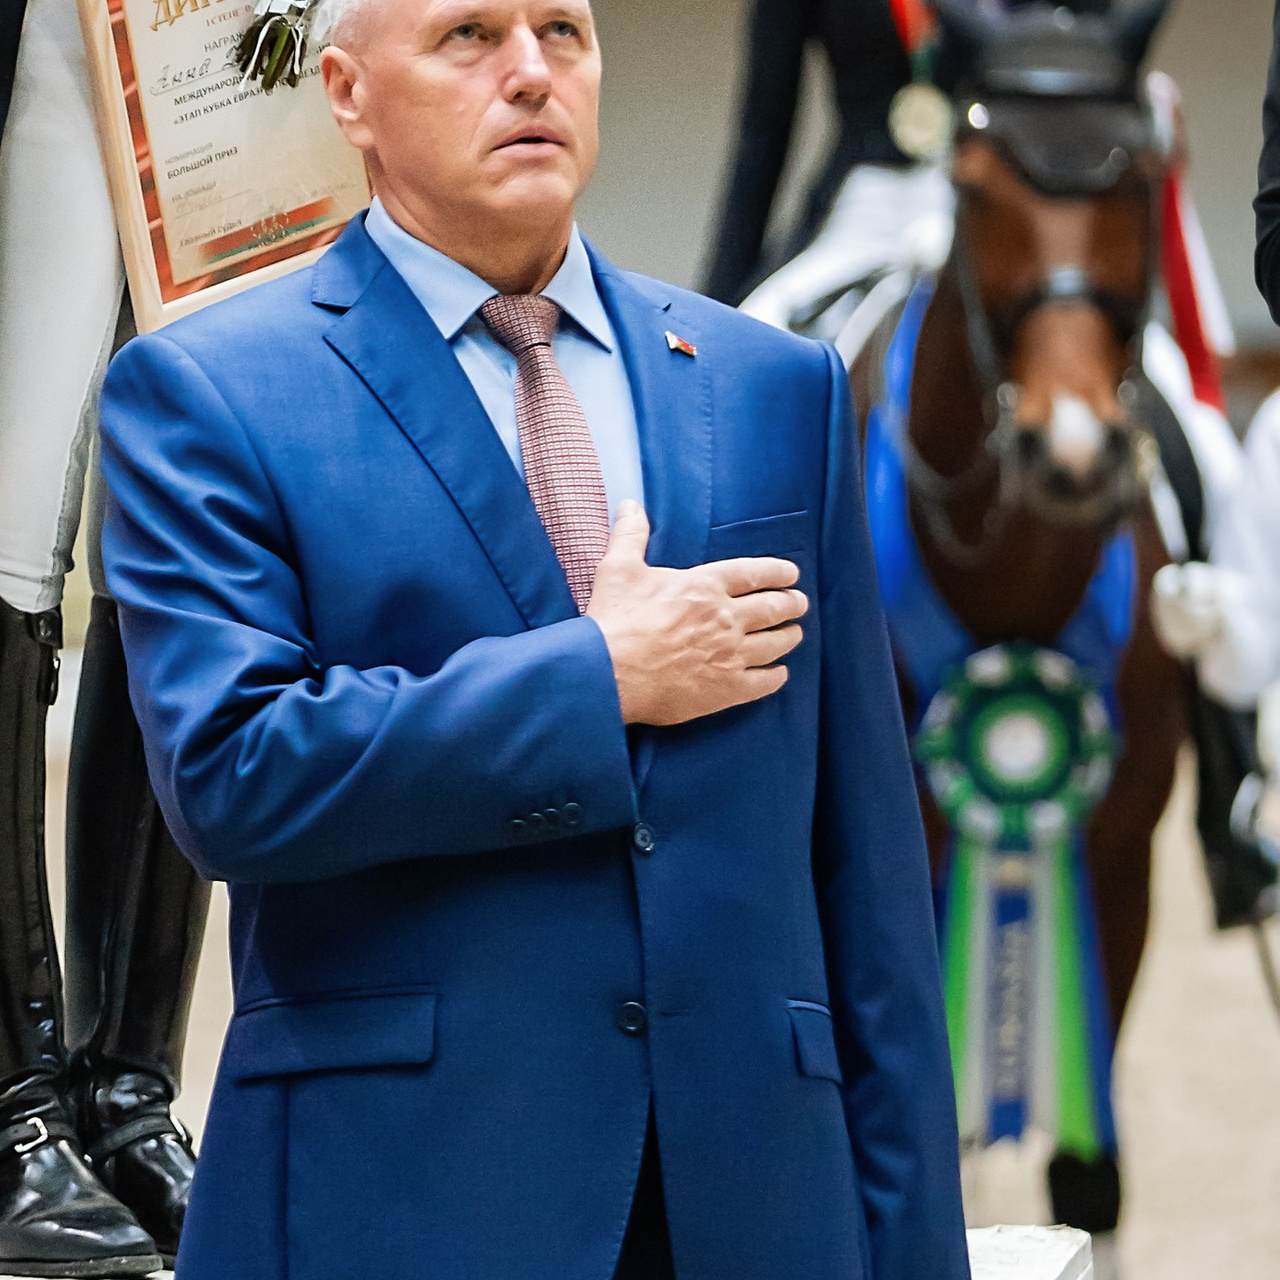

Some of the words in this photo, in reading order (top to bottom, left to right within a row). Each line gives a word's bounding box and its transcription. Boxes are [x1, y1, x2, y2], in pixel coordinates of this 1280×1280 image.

[203, 30, 246, 53] НАГРАЖ
[203, 98, 232, 114] КУБКА
[165, 142, 214, 166] НОМИНАЦИЯ
[166, 154, 213, 180] БОЛЬШОЙ
[215, 146, 238, 162] ПРИЗ
